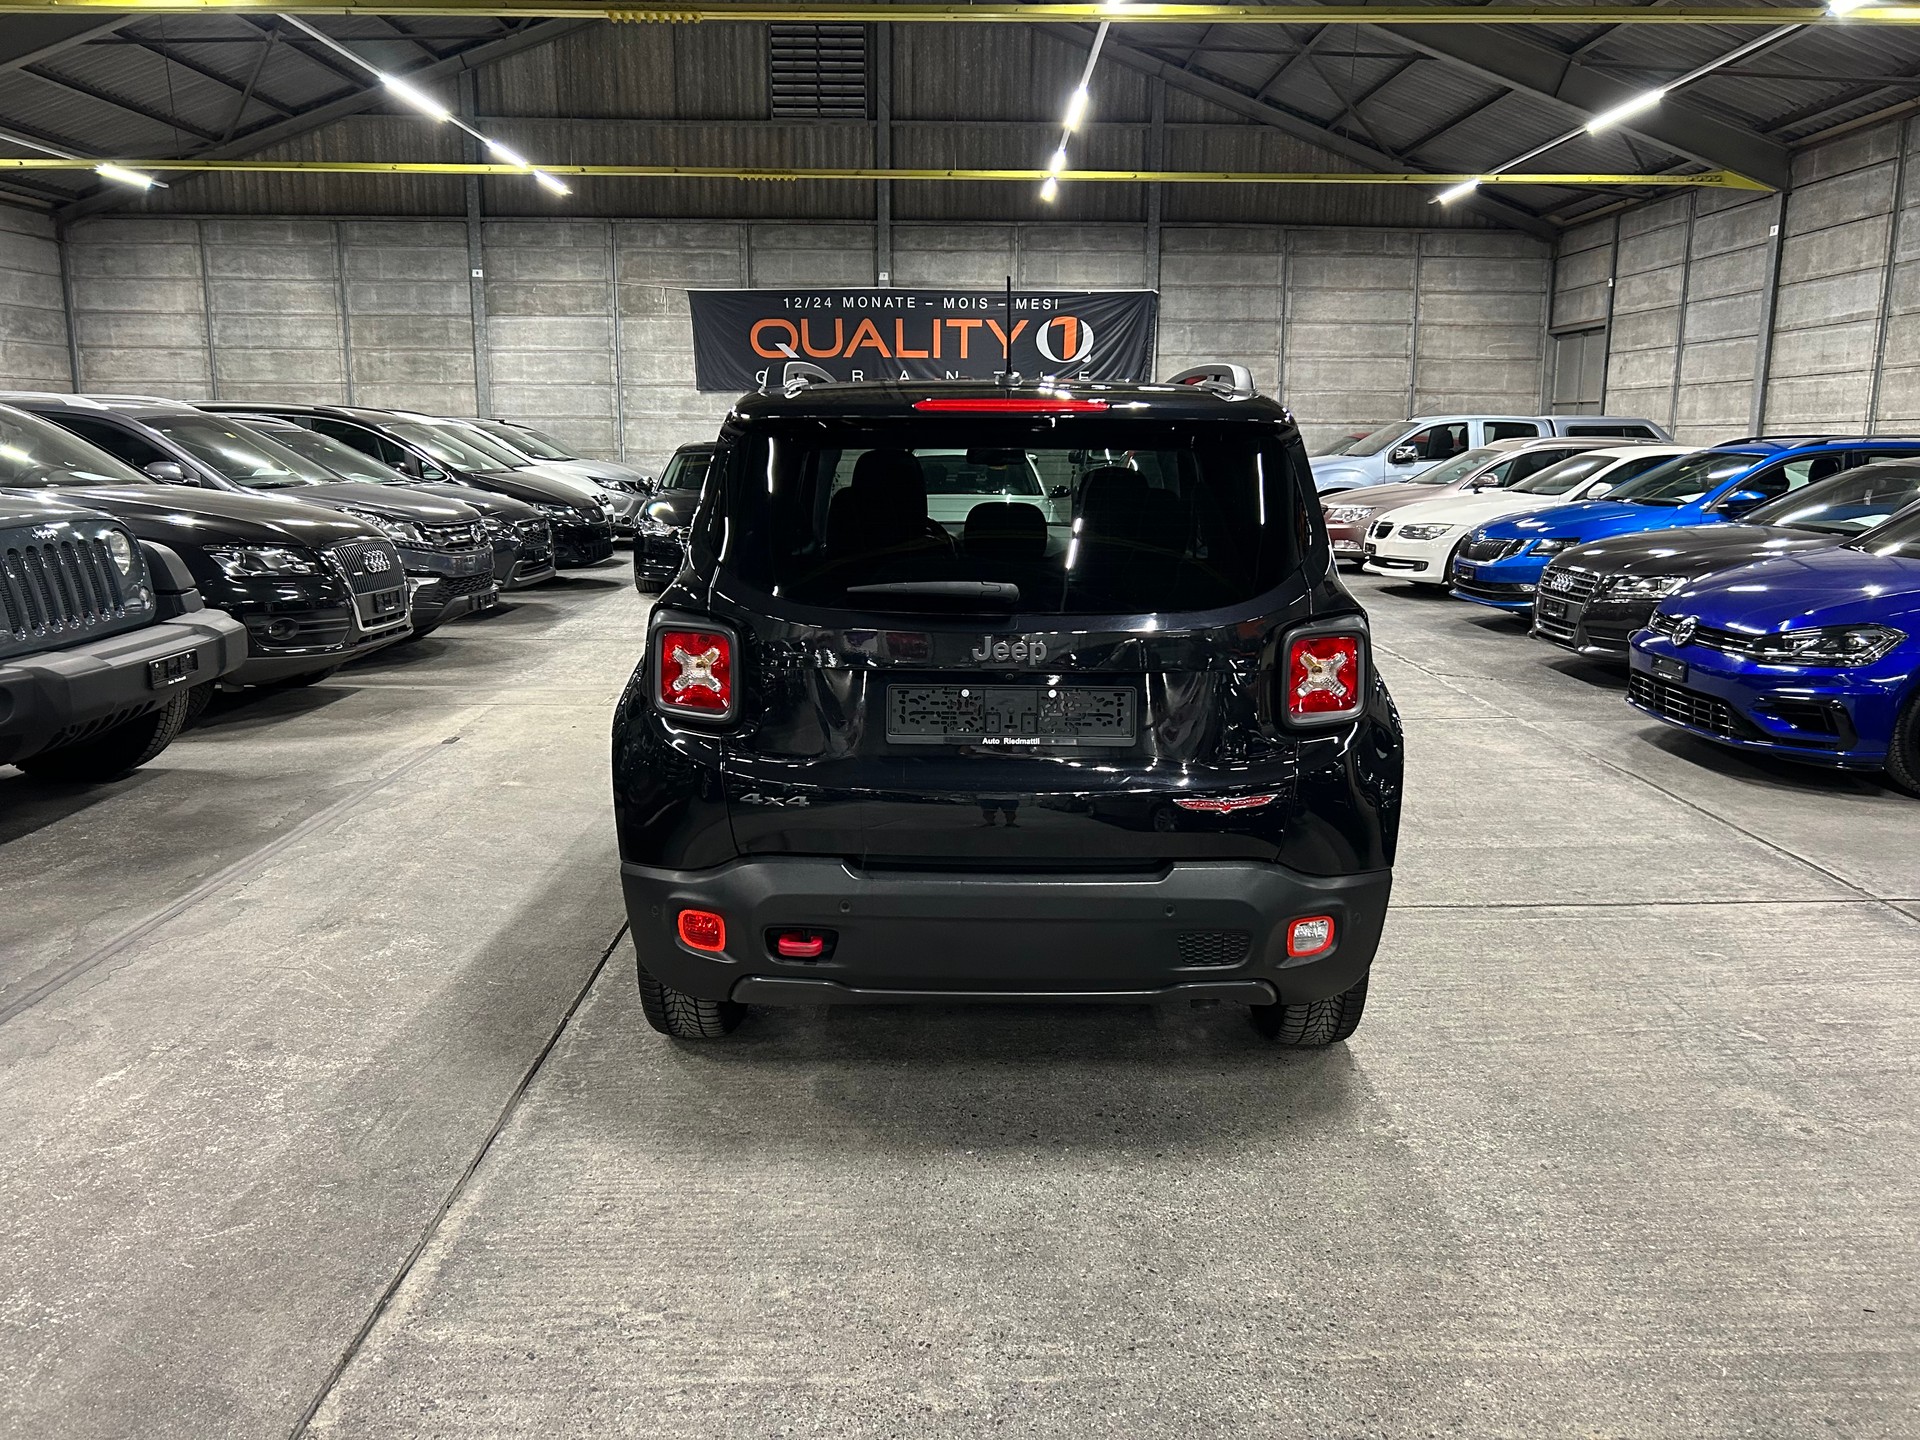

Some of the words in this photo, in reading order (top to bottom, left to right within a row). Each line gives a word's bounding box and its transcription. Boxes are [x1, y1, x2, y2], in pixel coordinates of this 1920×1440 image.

[784, 297, 832, 309] 12/24
[843, 297, 916, 309] MONATE
[943, 297, 988, 310] MOIS
[1015, 298, 1059, 310] MESI
[750, 318, 1029, 359] QUALITY
[972, 634, 1047, 666] Jeep
[982, 737, 1000, 745] Auto
[740, 793, 810, 807] 4x4
